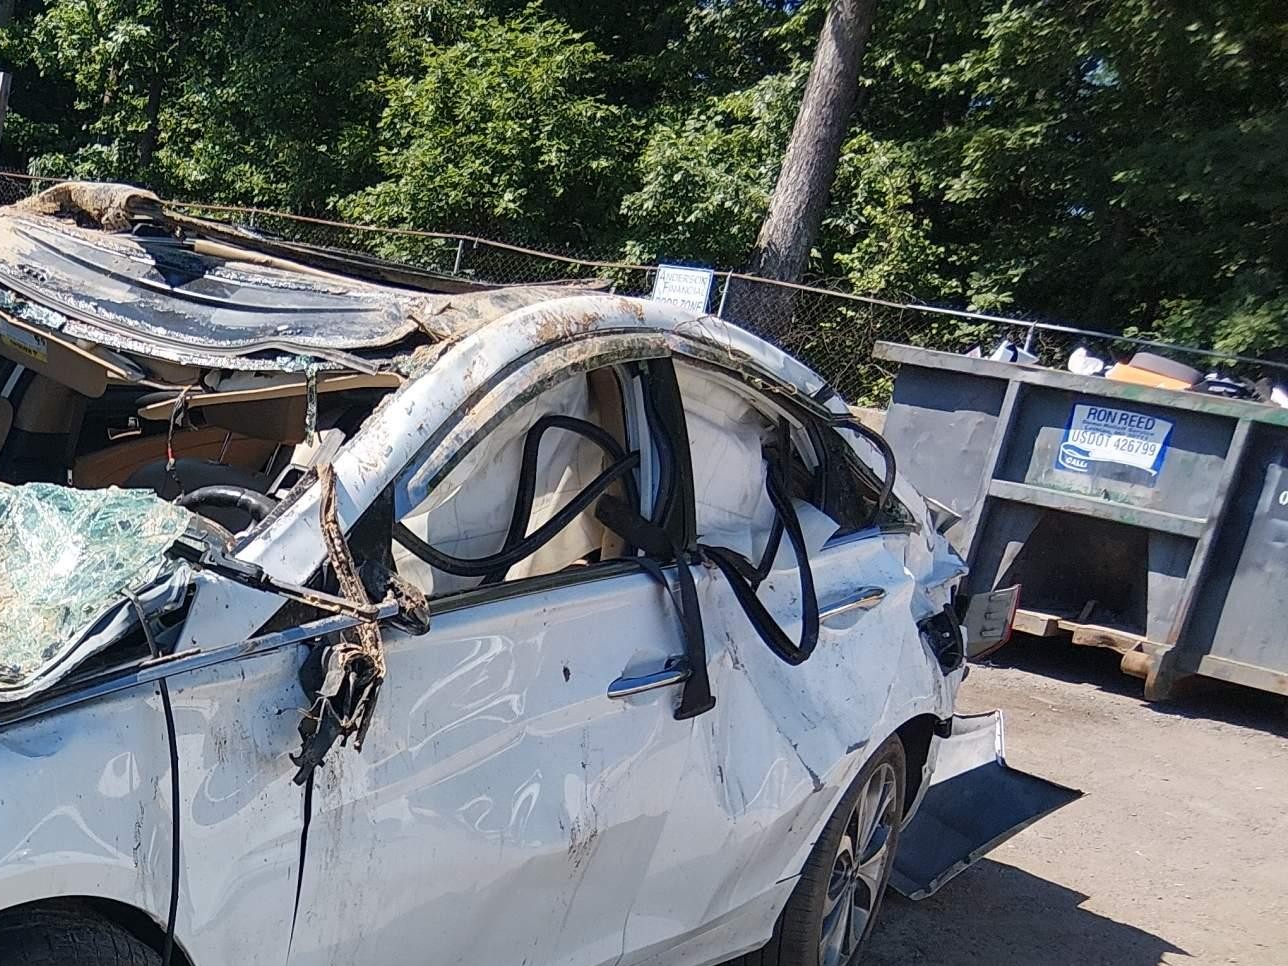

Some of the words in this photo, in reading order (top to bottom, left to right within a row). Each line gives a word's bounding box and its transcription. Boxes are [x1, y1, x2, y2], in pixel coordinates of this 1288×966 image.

[1087, 407, 1117, 423] RON
[1118, 413, 1156, 430] REED
[1113, 437, 1157, 457] 426799
